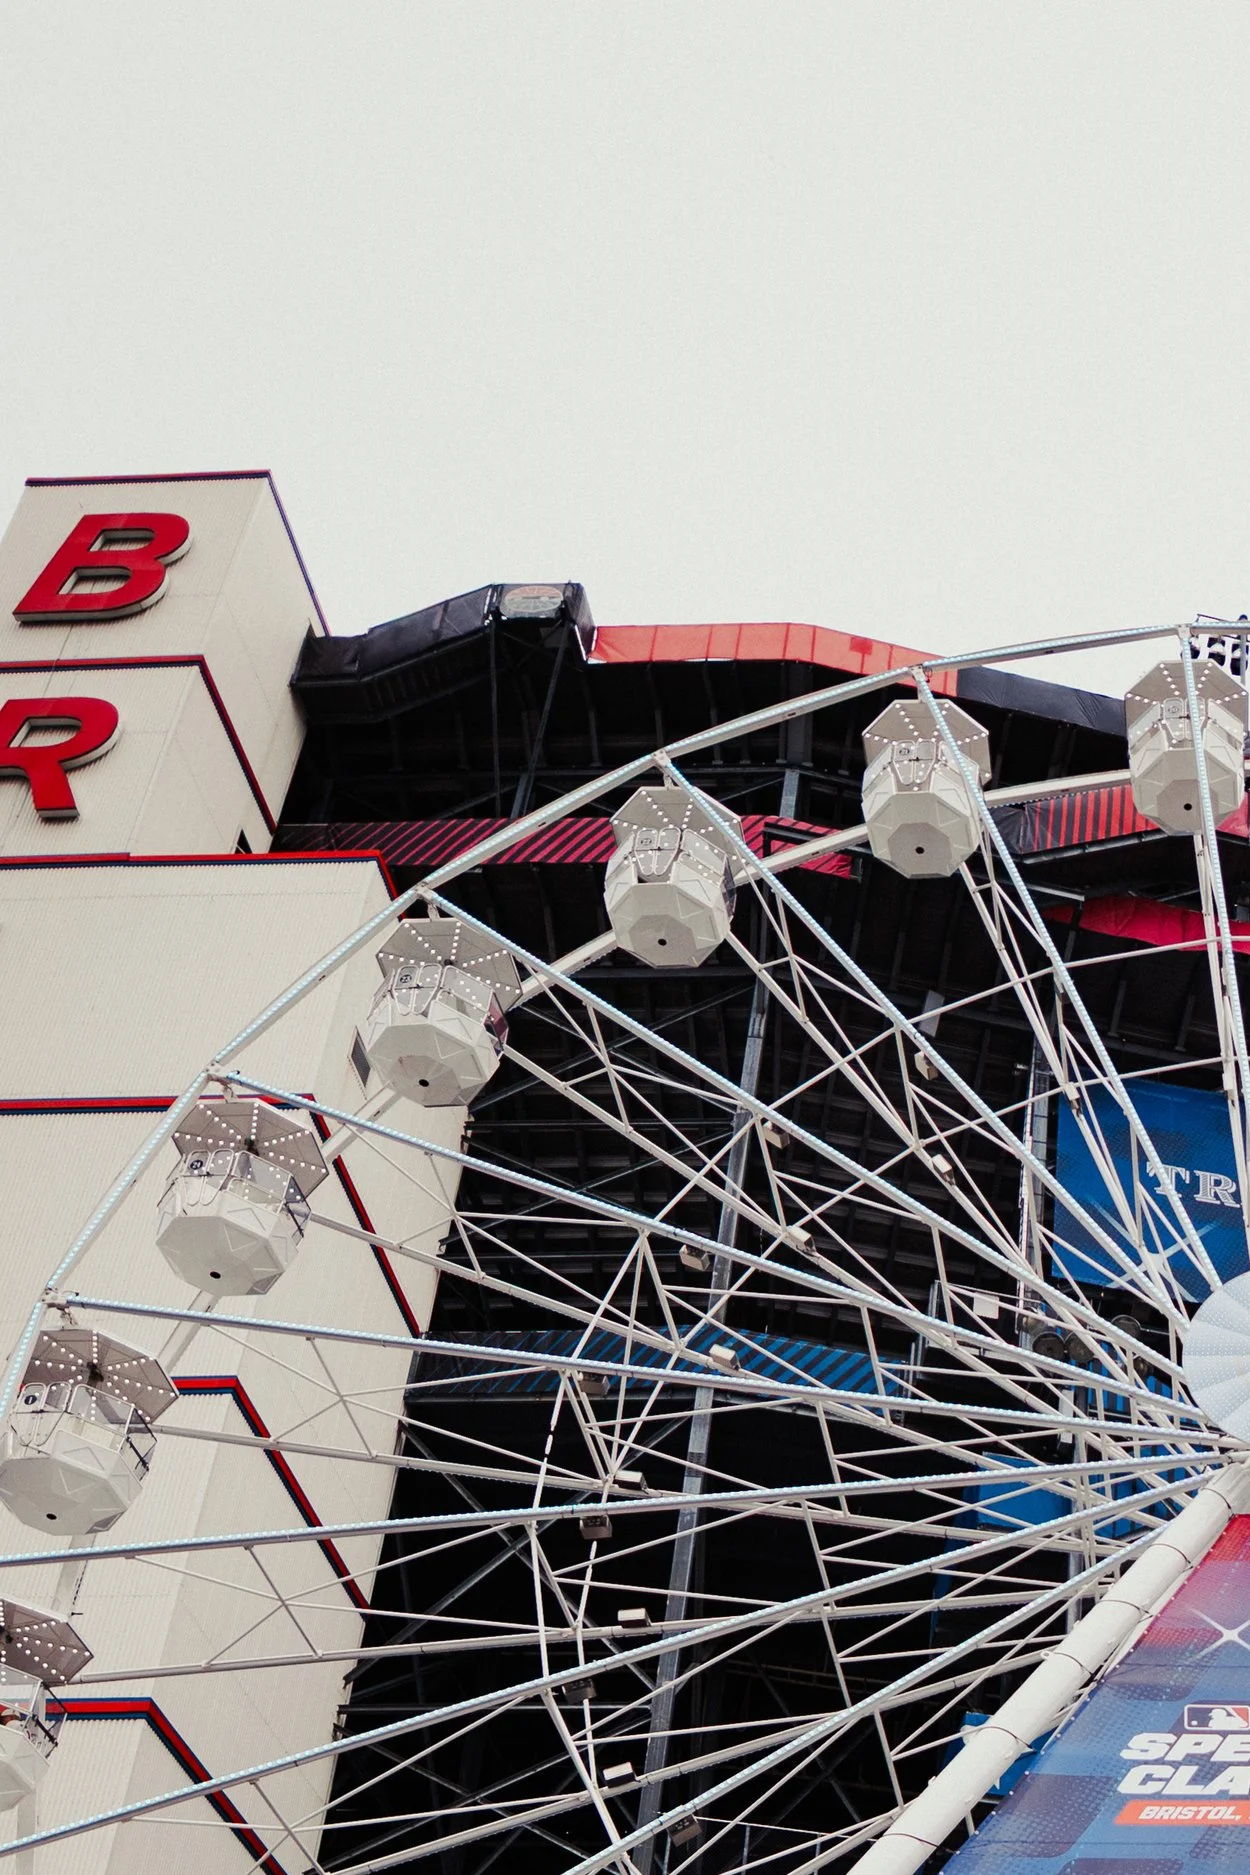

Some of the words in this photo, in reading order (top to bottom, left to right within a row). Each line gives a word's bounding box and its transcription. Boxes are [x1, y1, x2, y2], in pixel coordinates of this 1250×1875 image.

[12, 512, 190, 622] B
[0, 696, 119, 818] R
[1137, 1805, 1242, 1822] BRISTOL,
